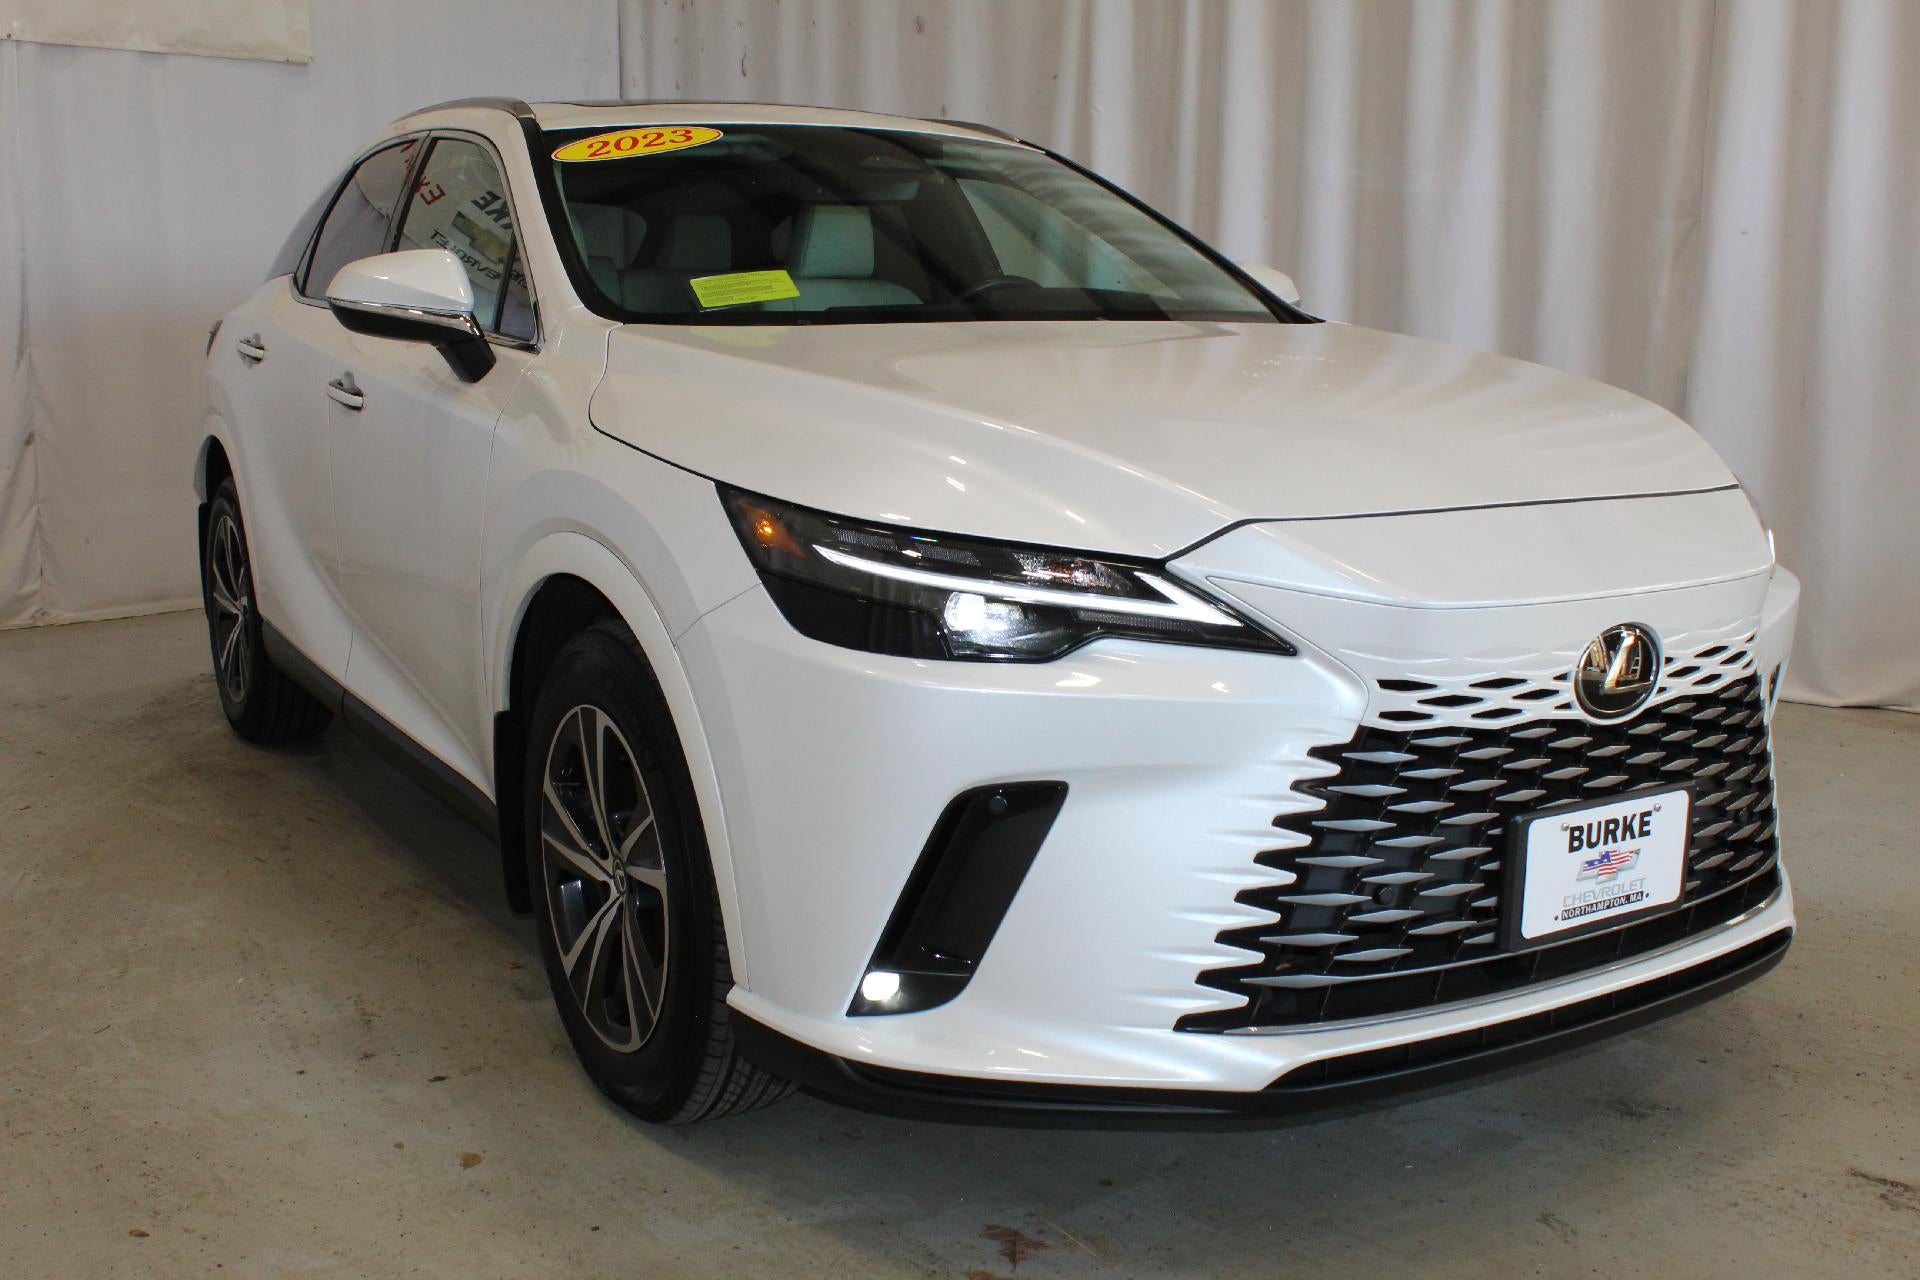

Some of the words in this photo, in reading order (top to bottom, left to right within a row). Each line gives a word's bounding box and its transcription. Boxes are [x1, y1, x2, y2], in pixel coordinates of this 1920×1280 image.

[587, 129, 694, 158] 2023
[1567, 810, 1653, 853] BURKE
[1563, 878, 1647, 908] CHEVROLET
[1629, 892, 1642, 902] MA
